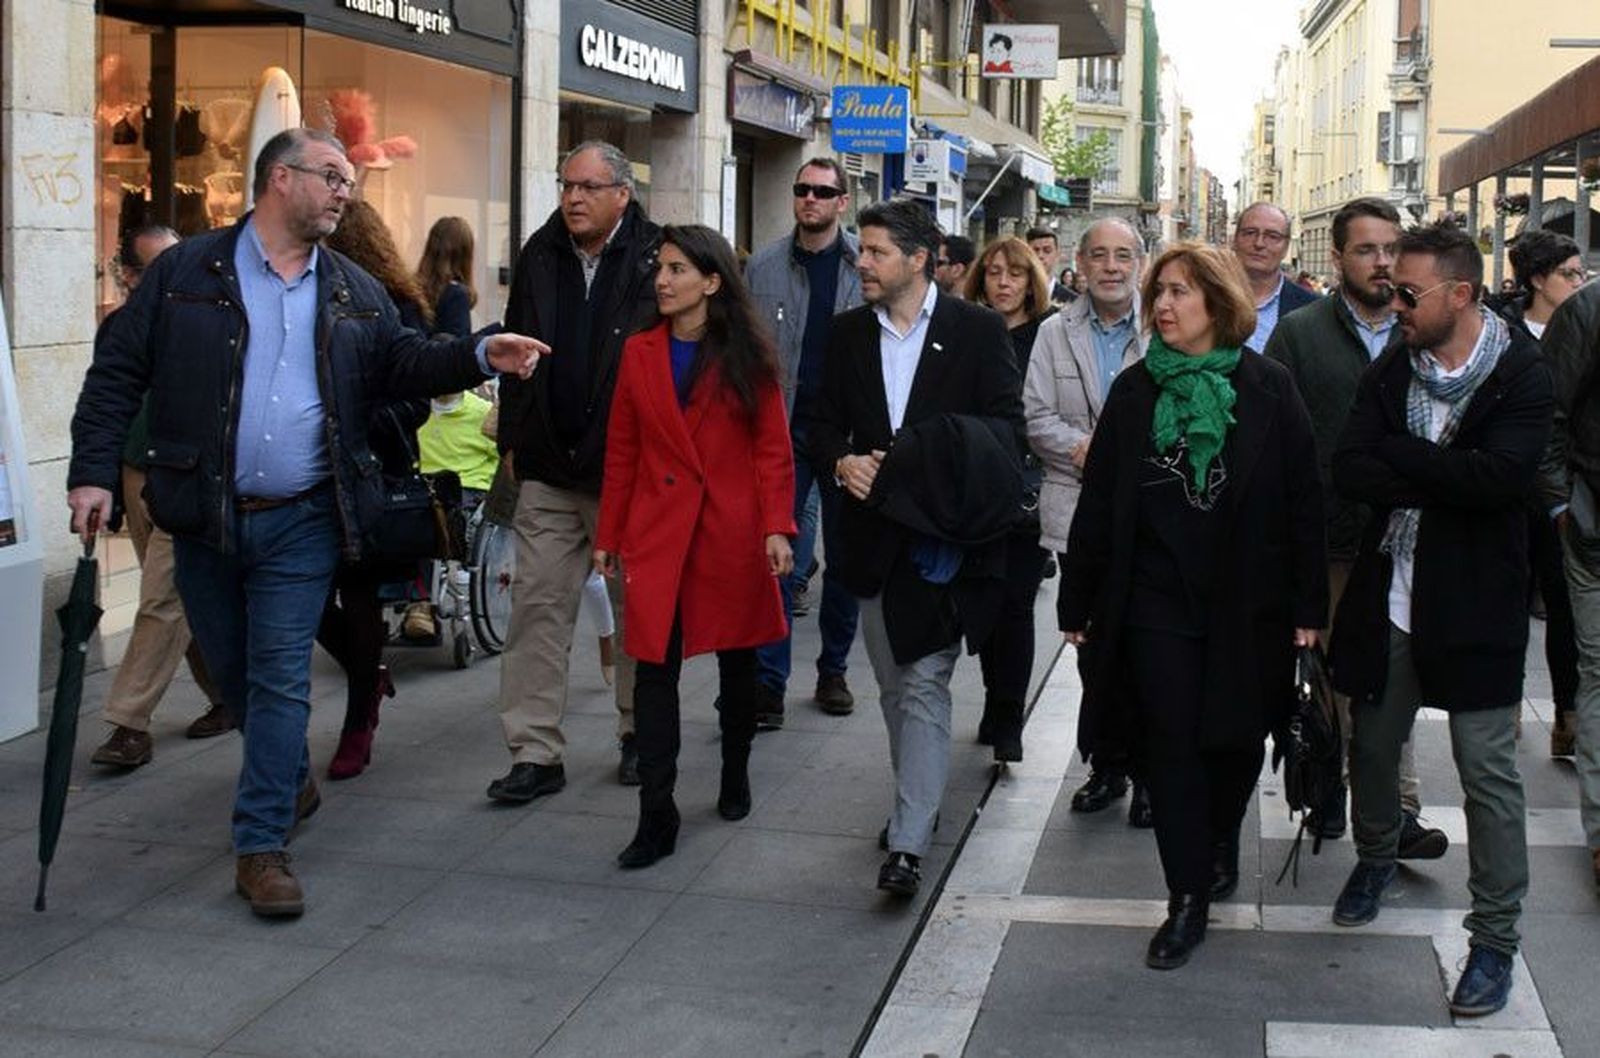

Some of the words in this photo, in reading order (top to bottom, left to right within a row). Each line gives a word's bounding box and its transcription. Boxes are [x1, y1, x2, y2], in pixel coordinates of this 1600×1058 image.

[397, 0, 451, 34] lingerie
[581, 24, 685, 92] CALZEDONIA
[836, 91, 903, 118] Paula
